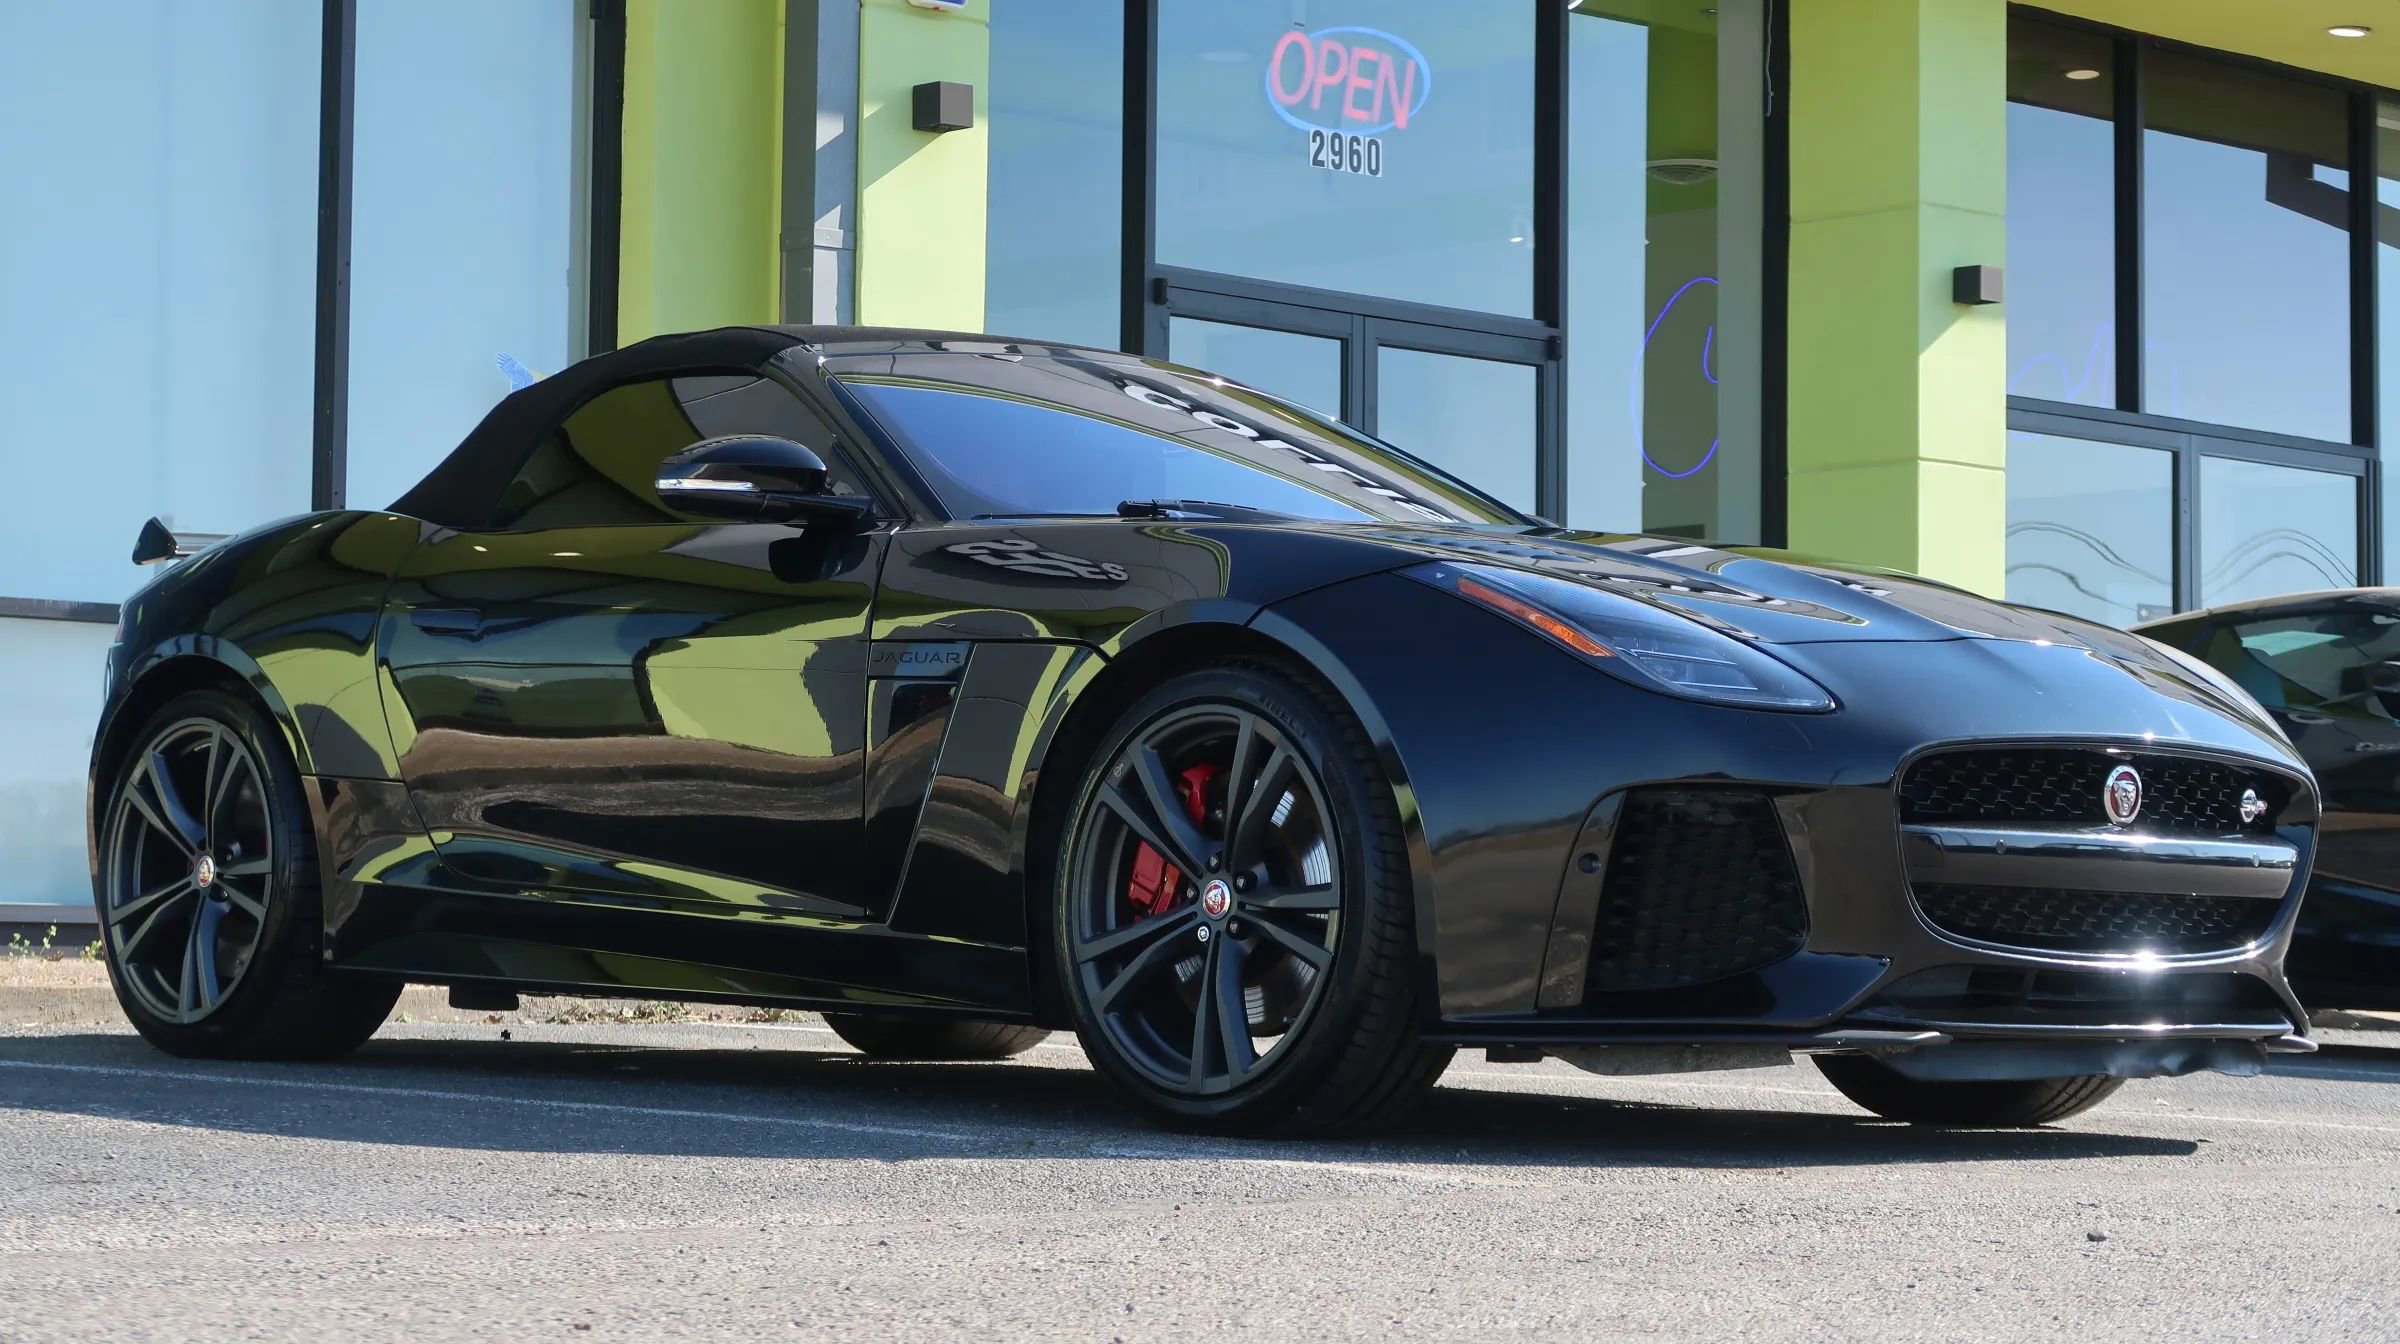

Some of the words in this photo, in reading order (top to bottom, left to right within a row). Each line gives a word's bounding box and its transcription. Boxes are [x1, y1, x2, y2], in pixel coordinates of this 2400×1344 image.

[1270, 31, 1416, 129] OPEN
[1311, 129, 1381, 176] 2960
[873, 651, 960, 664] JAGUAR
